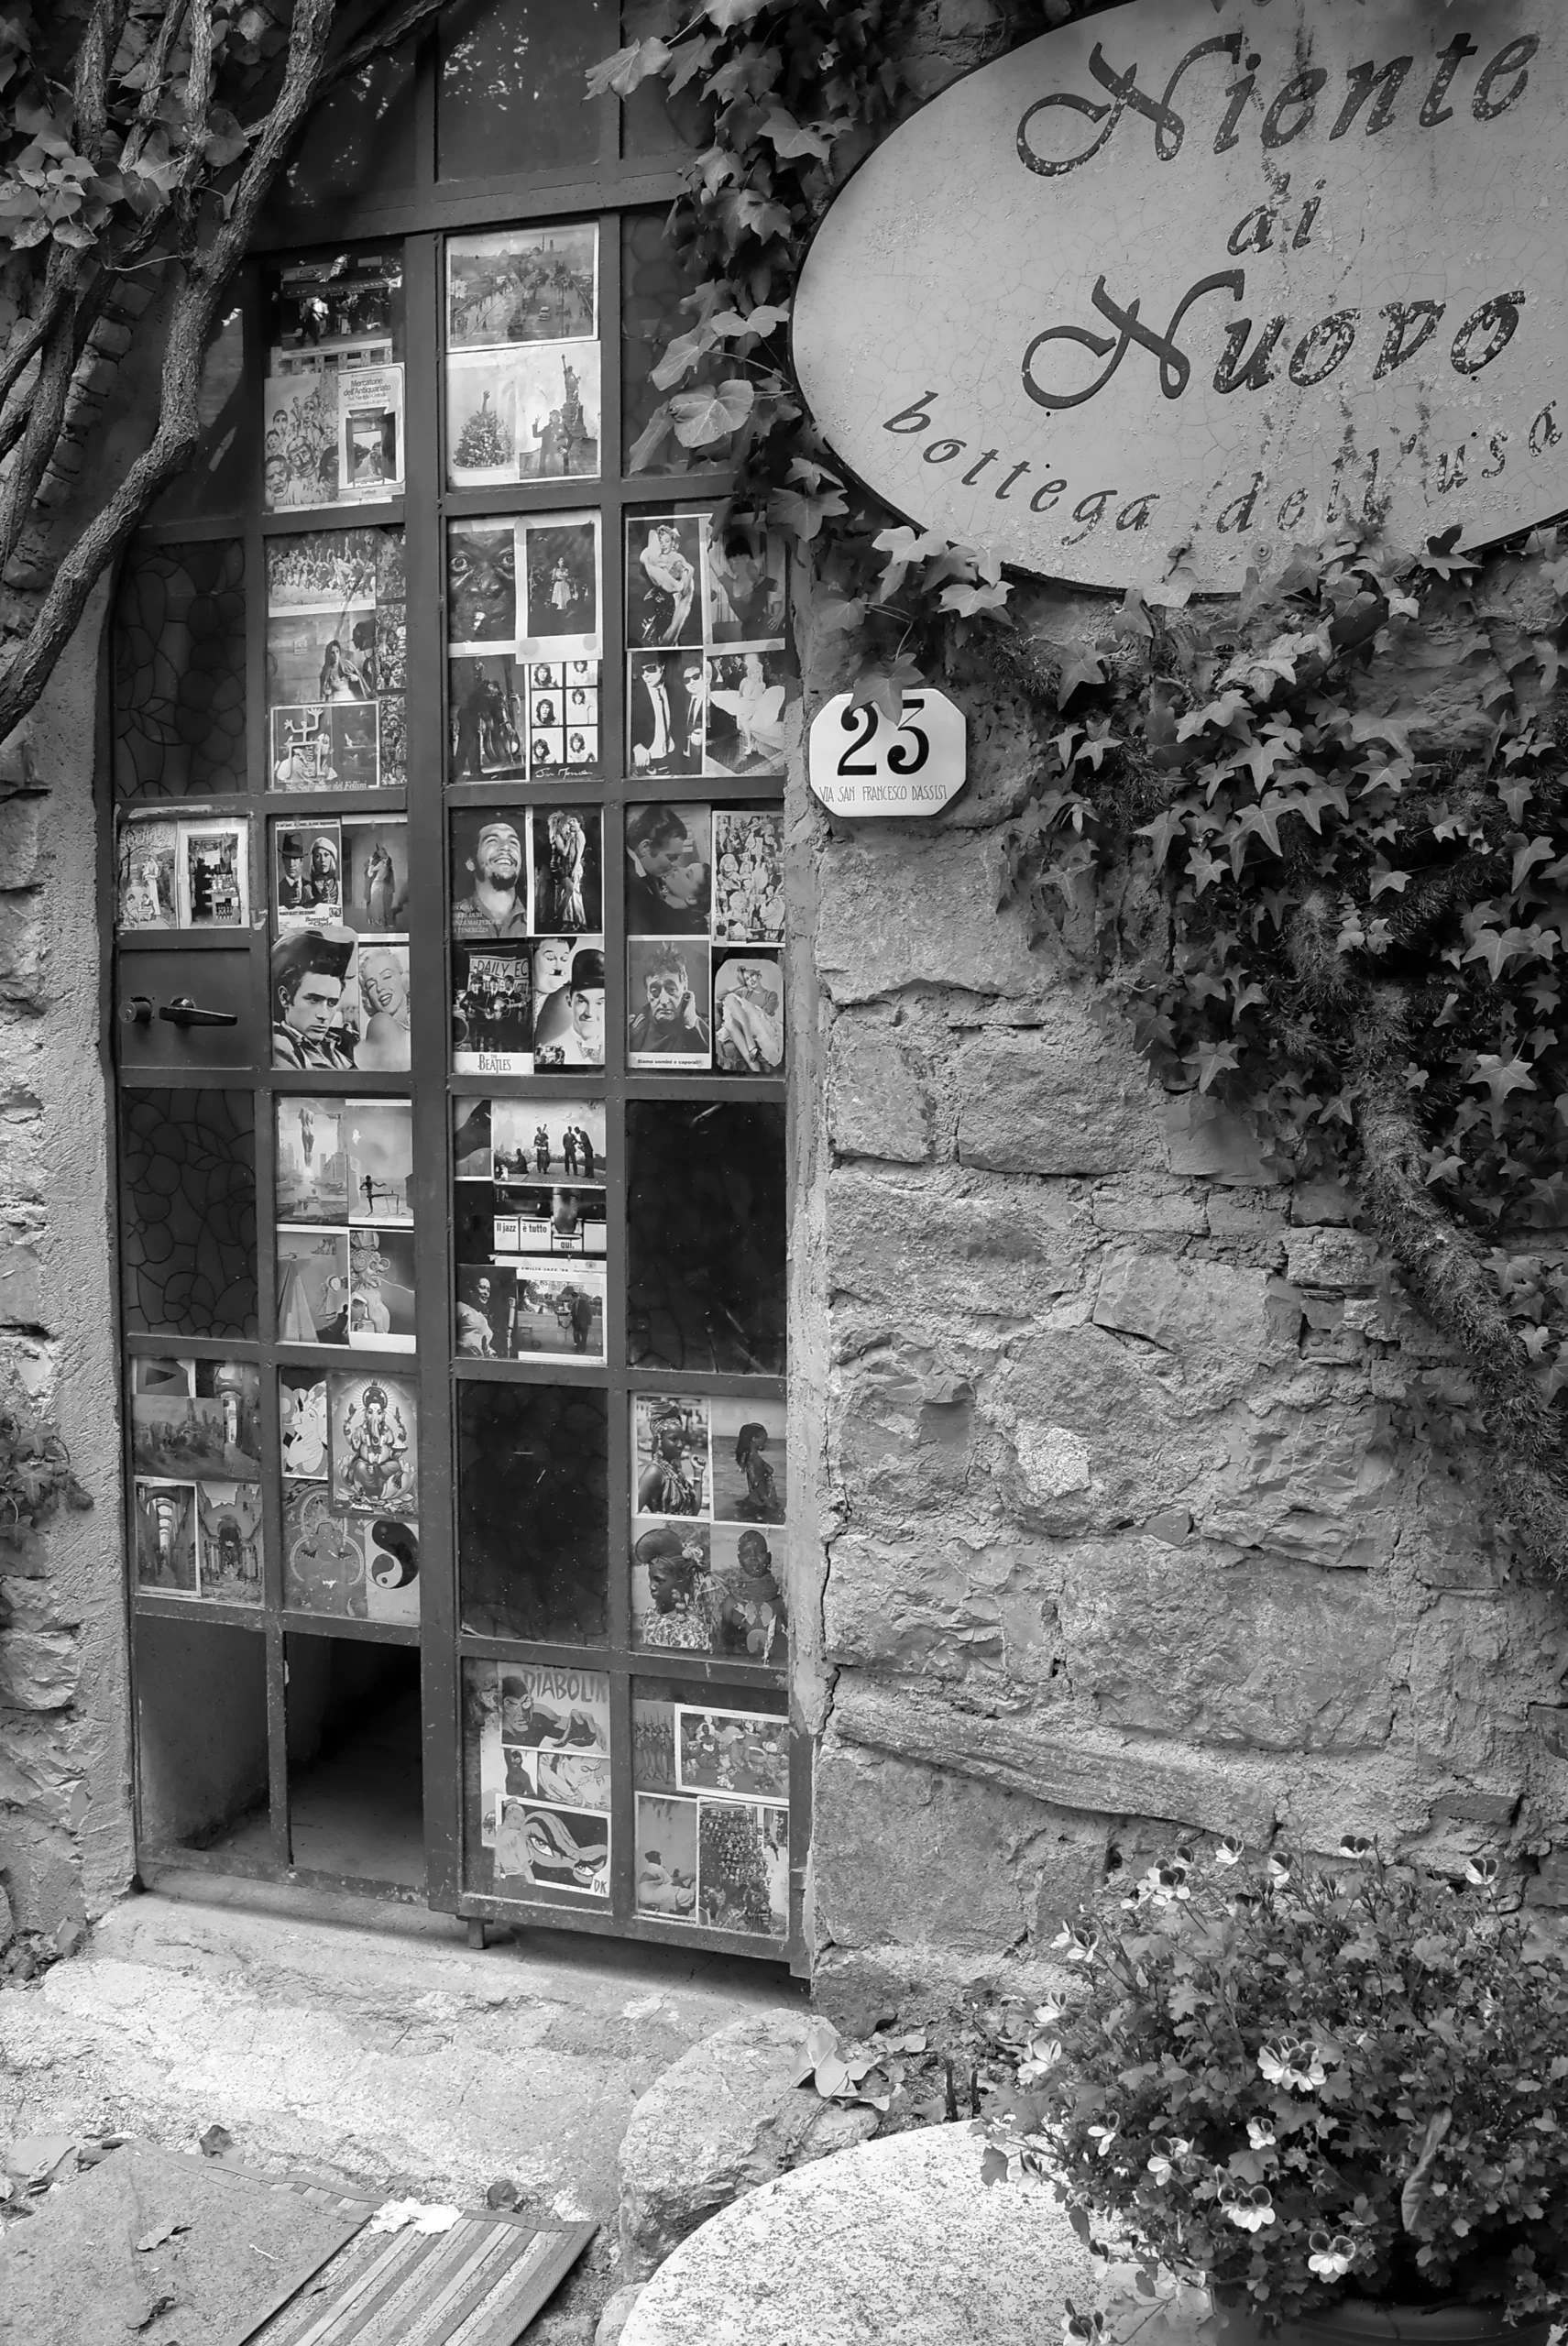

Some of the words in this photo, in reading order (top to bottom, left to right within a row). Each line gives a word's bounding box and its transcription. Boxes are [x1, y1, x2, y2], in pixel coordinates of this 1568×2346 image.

[1016, 32, 1541, 178] Niente
[1227, 173, 1326, 257] di
[1022, 269, 1526, 411] Nuovo
[343, 384, 391, 396] dell'Antiquariato
[351, 378, 383, 388] Mercatone
[883, 390, 1161, 546] bottega
[837, 698, 929, 776] 23
[818, 785, 834, 802] VIA
[837, 785, 855, 802] SAN
[862, 784, 907, 801] FRANCESCO
[477, 959, 510, 977] DAILY
[502, 1223, 516, 1233] jazz
[522, 1222, 528, 1233] è
[529, 1224, 547, 1233] tutto
[561, 1239, 575, 1249] qui.
[594, 1879, 608, 1894] DK
